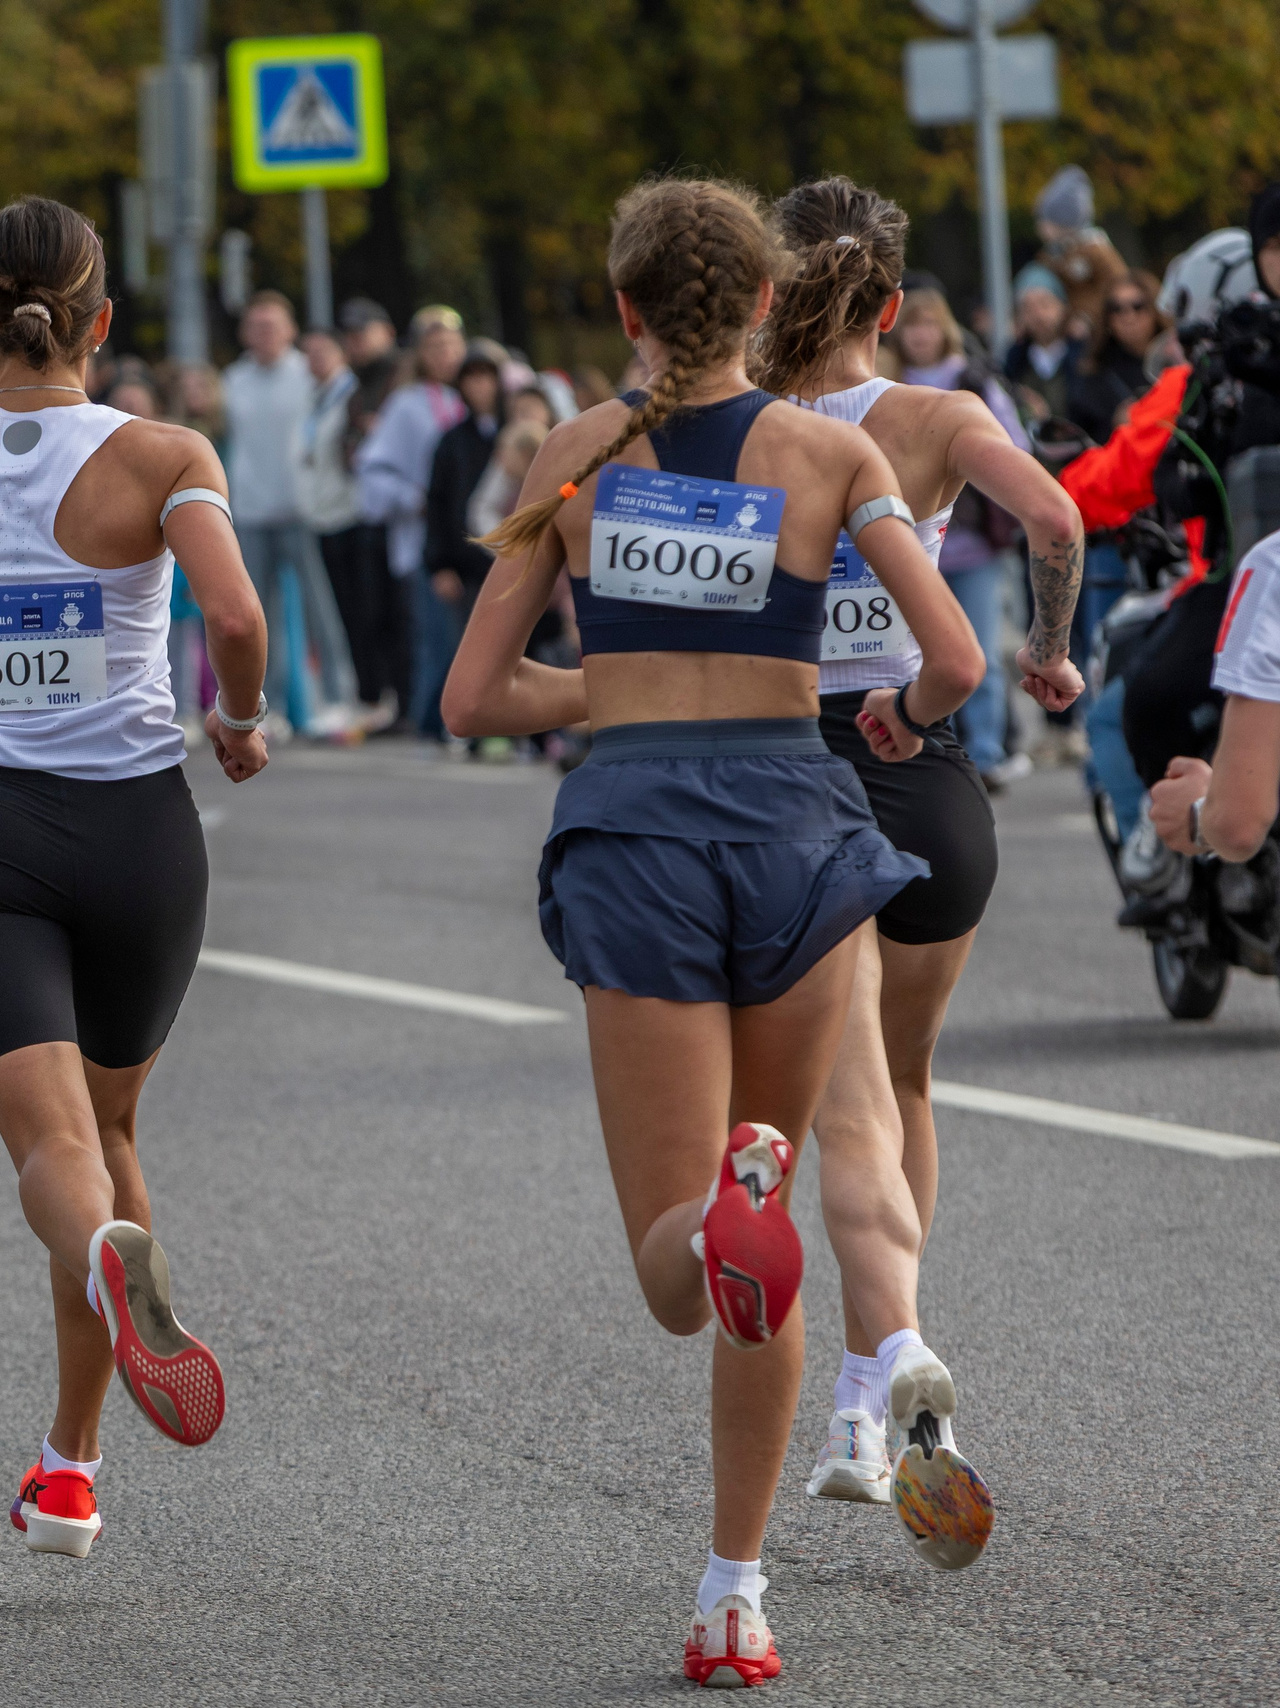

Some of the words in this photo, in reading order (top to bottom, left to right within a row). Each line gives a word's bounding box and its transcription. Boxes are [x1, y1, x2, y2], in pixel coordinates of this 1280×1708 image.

[624, 487, 673, 501] ПОЛУМАРАФОН
[614, 495, 636, 506] МОЯ
[637, 498, 687, 515] СТОЛИЦА
[606, 532, 755, 585] 16006
